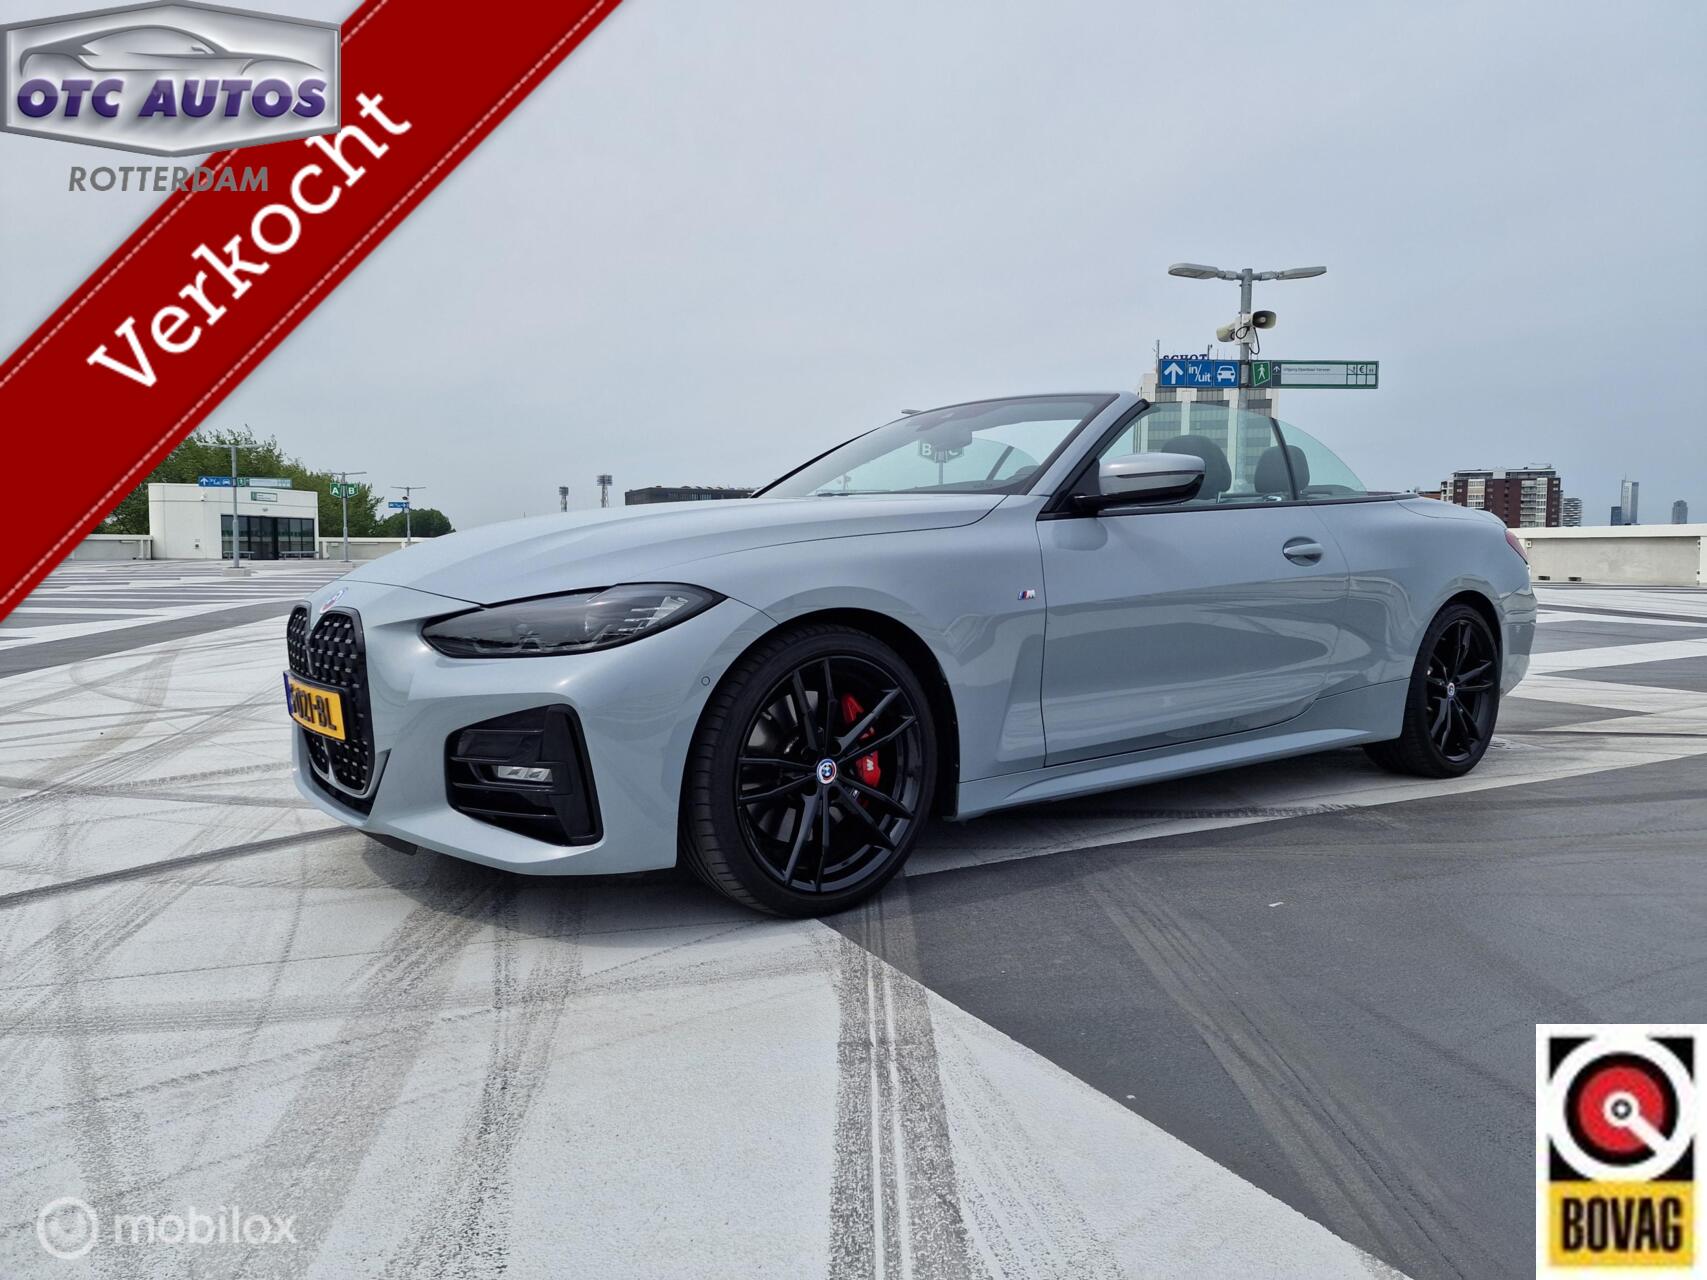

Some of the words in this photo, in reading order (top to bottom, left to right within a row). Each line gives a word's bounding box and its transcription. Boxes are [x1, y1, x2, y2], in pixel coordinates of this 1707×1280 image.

[922, 443, 932, 456] B
[332, 487, 339, 495] A
[348, 487, 356, 495] B
